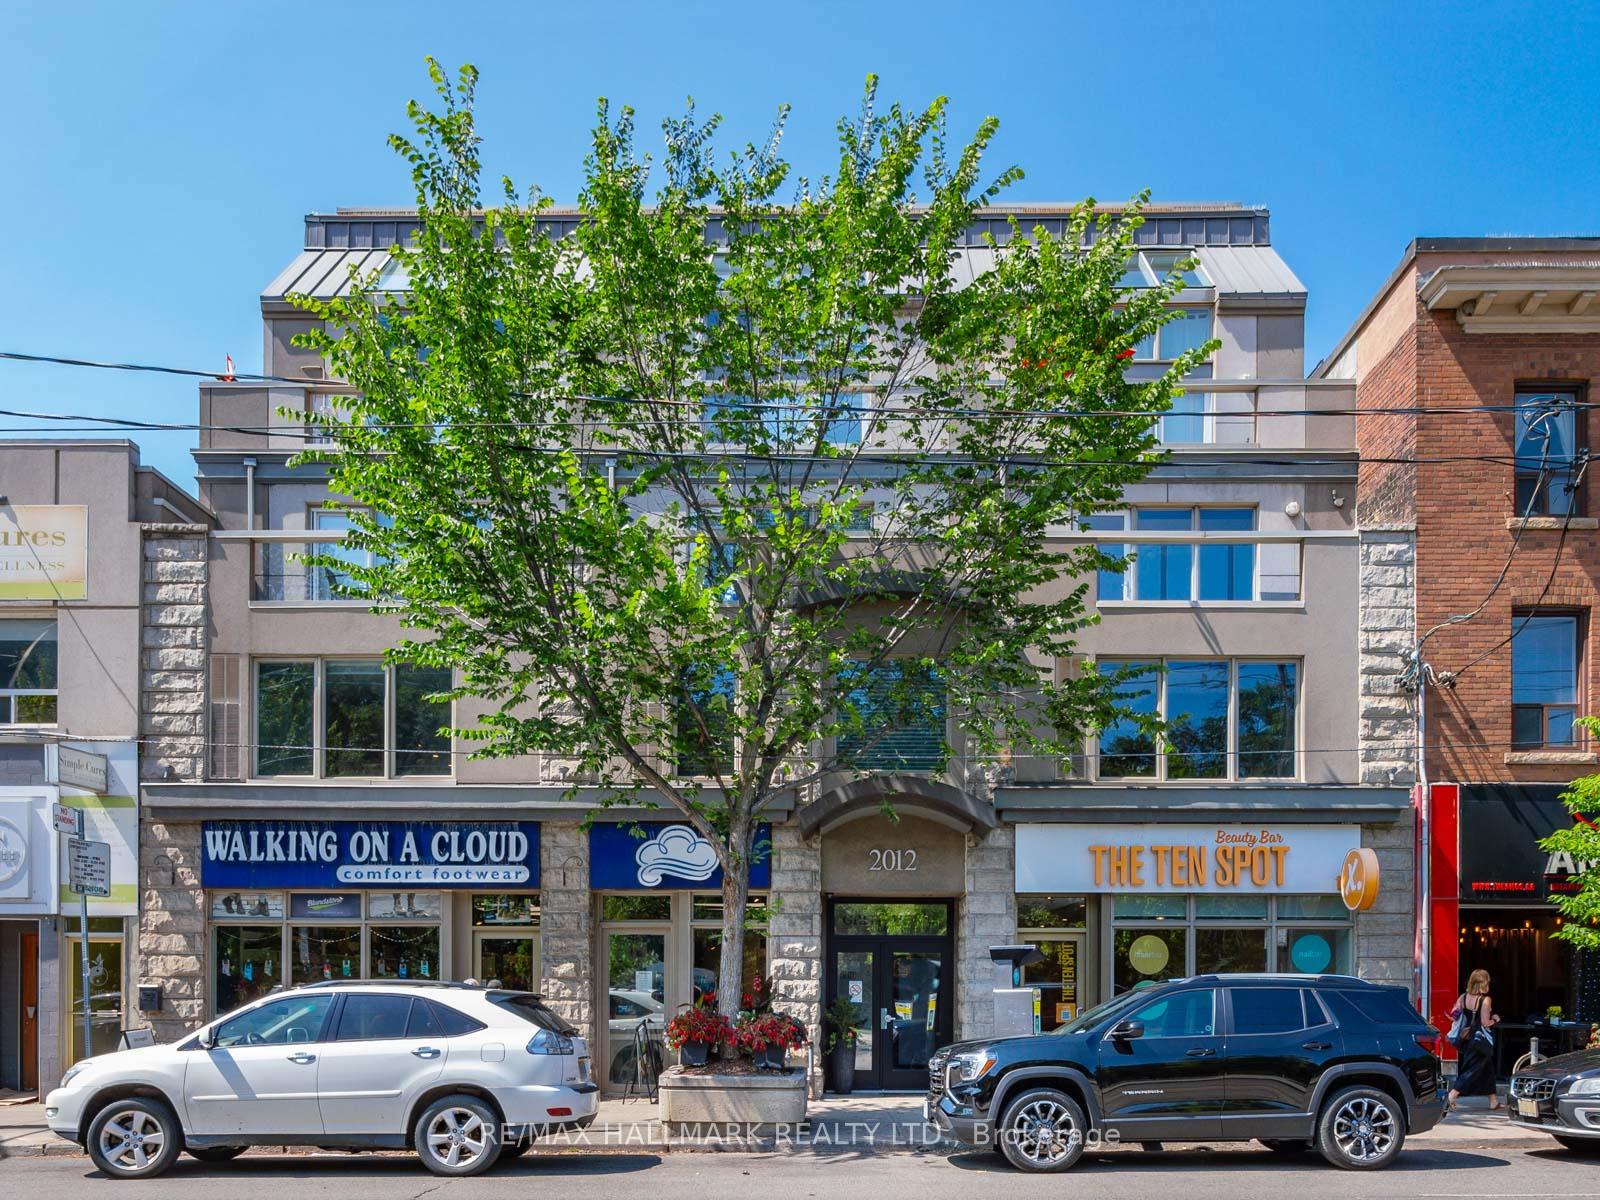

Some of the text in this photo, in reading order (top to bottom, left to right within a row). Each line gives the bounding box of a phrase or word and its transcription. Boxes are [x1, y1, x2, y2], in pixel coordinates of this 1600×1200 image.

[60, 754, 83, 774] Simple
[205, 830, 529, 863] WALKING ON A CLOUD
[1215, 829, 1284, 848] Beauty Bar
[869, 849, 917, 871] 2012
[1088, 845, 1290, 887] THE TEN SPOT
[343, 868, 523, 880] comfort footwear
[1062, 943, 1075, 1002] THE TEN SPOT
